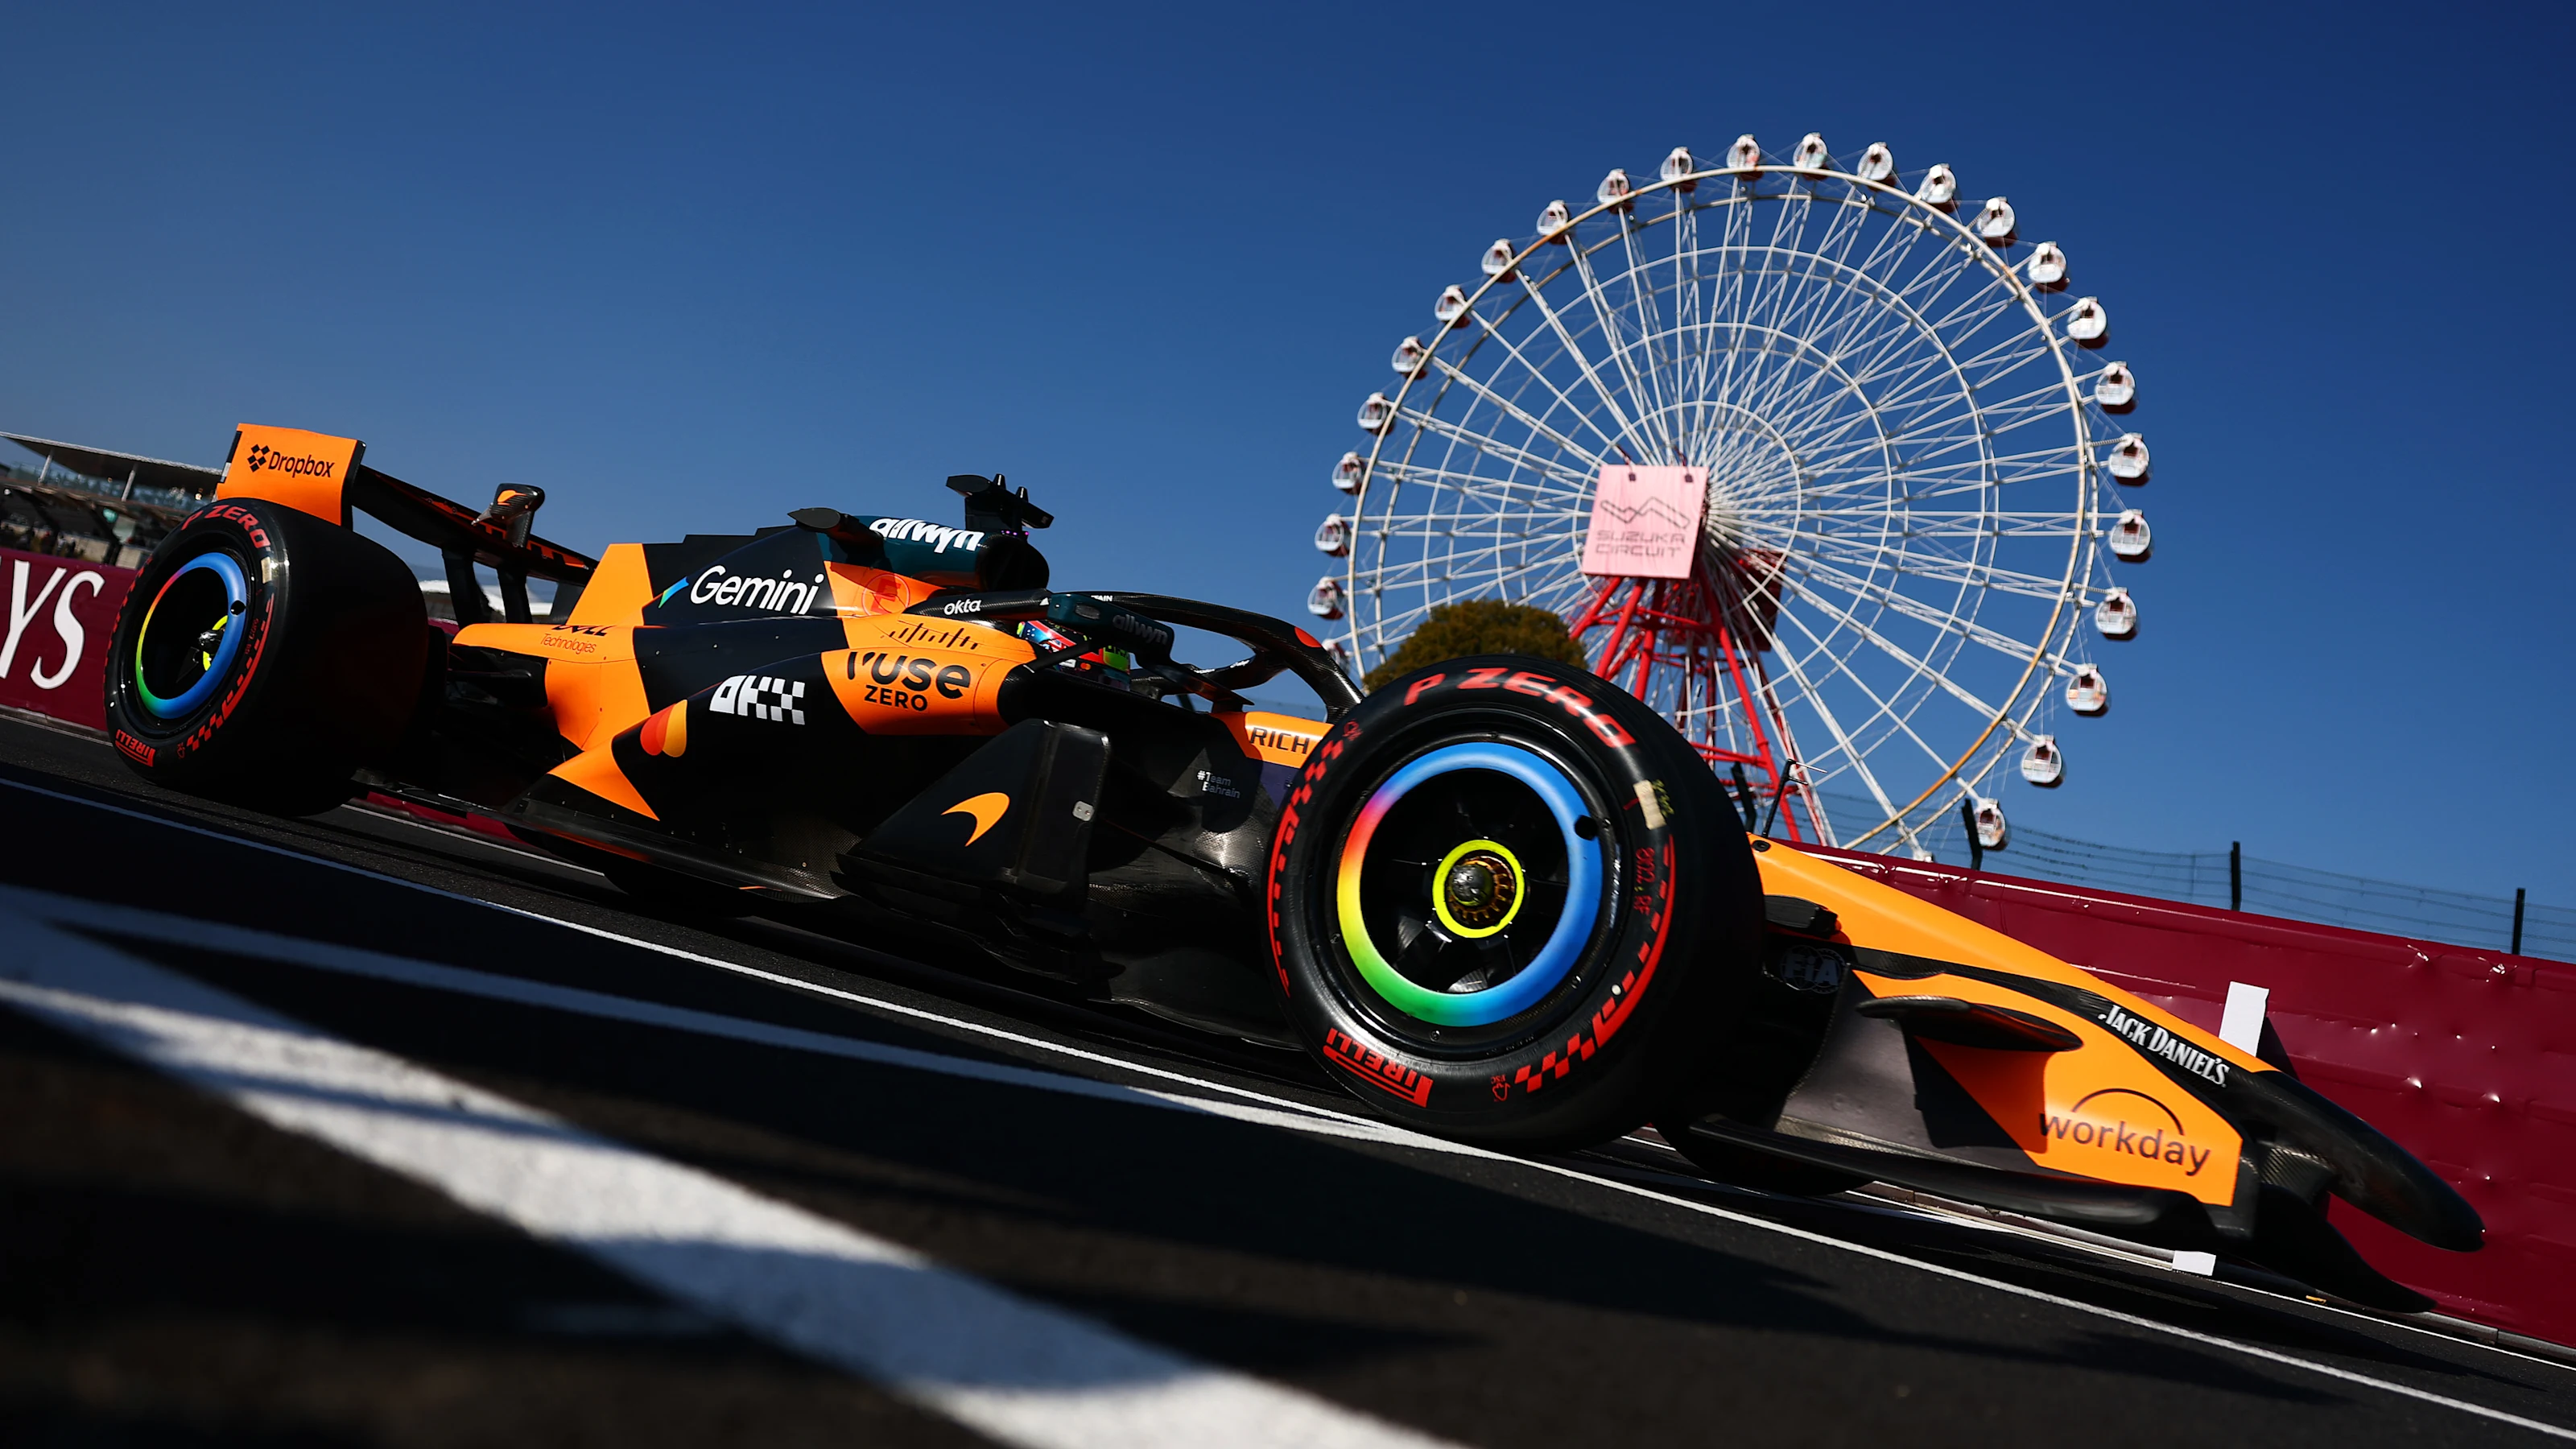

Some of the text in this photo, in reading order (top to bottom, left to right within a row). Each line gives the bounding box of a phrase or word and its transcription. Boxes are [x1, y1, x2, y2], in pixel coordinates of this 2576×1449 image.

[268, 451, 335, 477] Dropbox
[181, 504, 270, 548] P ZERO
[869, 518, 985, 553] allwyn
[1596, 530, 1686, 544] SUZUKA
[1596, 543, 1682, 558] CIRCUIT
[691, 565, 824, 614] Gemini
[943, 599, 982, 615] okta
[0, 555, 105, 689] YS
[540, 633, 597, 654] Technologies
[864, 684, 928, 712] ZERO
[1404, 667, 1637, 749] P ZERO
[114, 729, 156, 767] PIRELLI
[1197, 770, 1232, 786] #Team
[1202, 781, 1241, 799] Bahrain
[2098, 1005, 2230, 1087] JACK DANIEL'S
[1322, 1027, 1434, 1108] PIRELLI
[2038, 1113, 2211, 1176] workday
